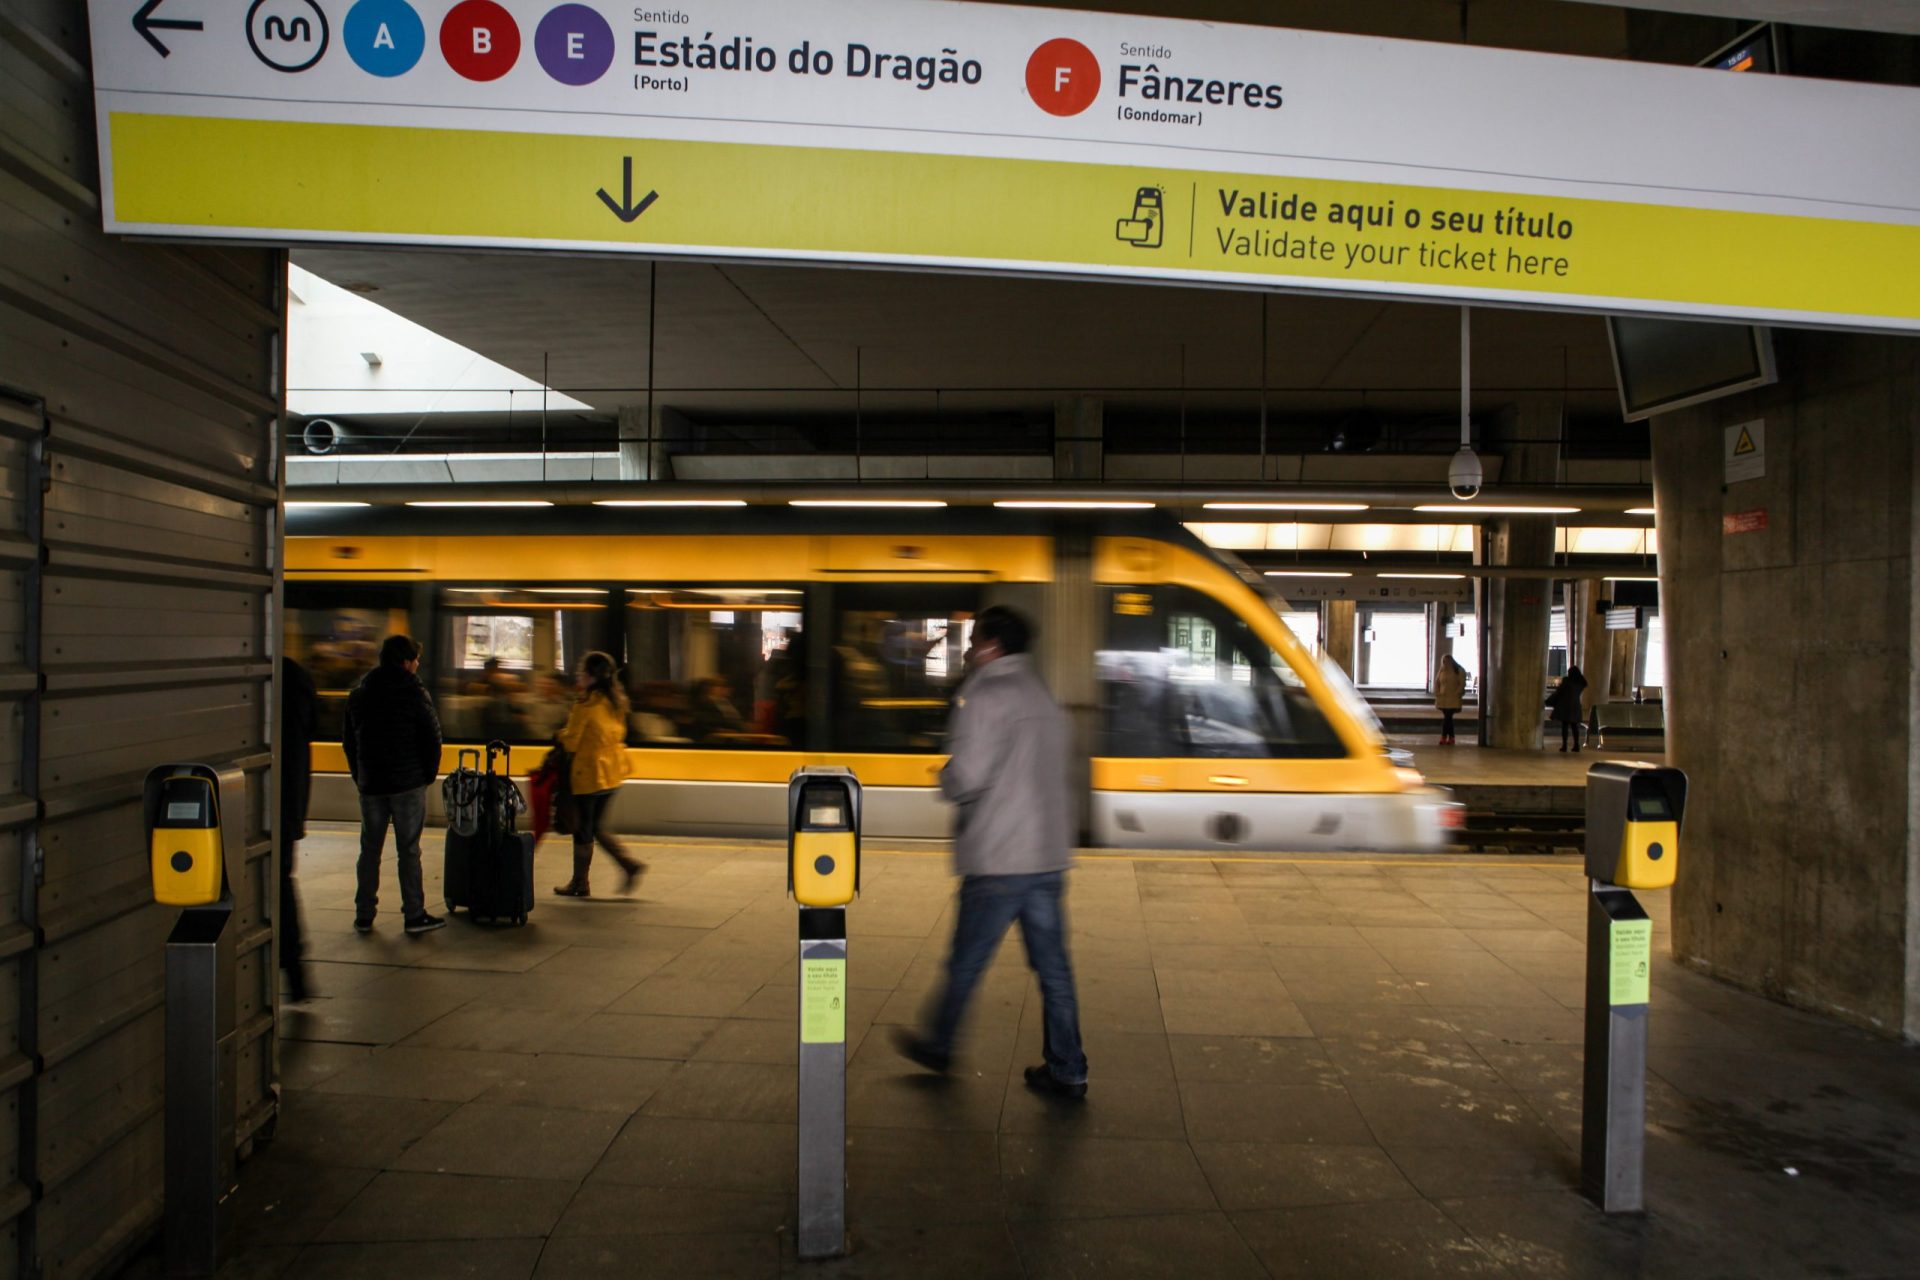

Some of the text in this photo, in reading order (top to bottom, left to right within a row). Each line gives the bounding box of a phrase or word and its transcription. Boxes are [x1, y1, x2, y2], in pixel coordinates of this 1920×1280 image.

[634, 8, 689, 24] Sentido
[373, 22, 395, 49] A
[472, 27, 492, 54] B
[567, 32, 584, 59] E
[1120, 42, 1172, 60] Sentido
[634, 31, 982, 91] Estádio do Dragão
[634, 74, 688, 92] (Porto)
[1054, 67, 1072, 92] F
[1118, 64, 1283, 110] Fânzeres
[1117, 105, 1202, 126] (Gondomar)
[1218, 188, 1573, 240] Valide aqui o seu título
[1216, 227, 1569, 277] Validate your ticket here
